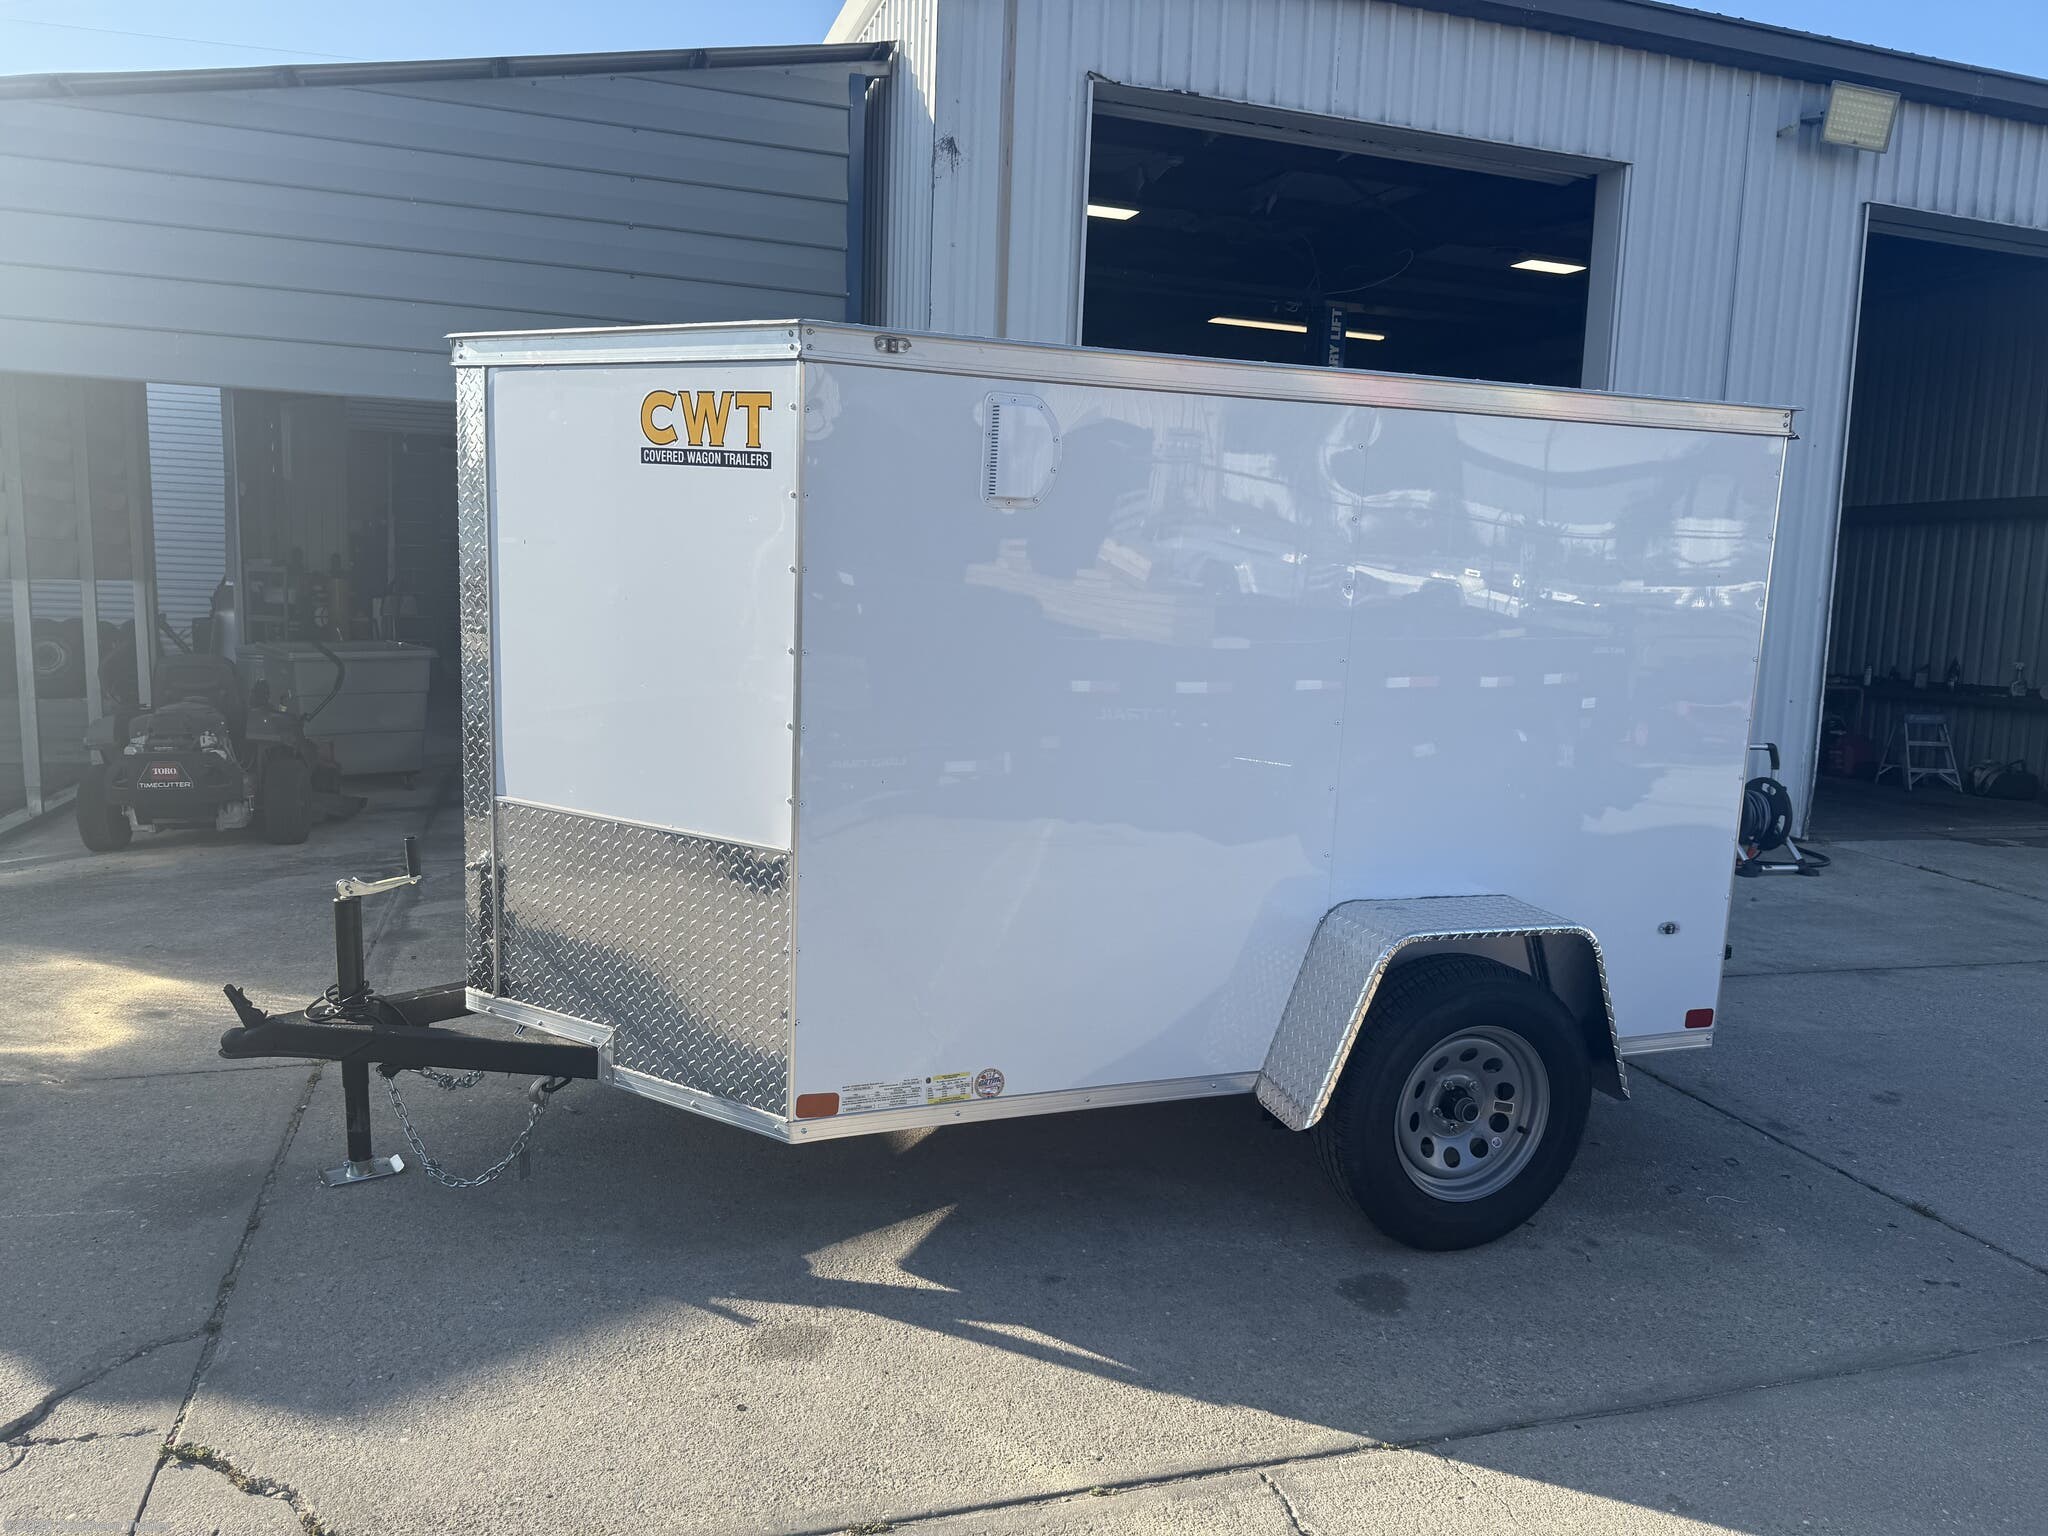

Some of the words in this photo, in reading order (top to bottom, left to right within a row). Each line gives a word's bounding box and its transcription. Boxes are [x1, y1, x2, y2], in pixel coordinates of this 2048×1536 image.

[1330, 308, 1342, 340] LIFT
[641, 390, 772, 448] CWT
[643, 449, 684, 463] COVERED
[686, 451, 721, 465] WAGON
[723, 452, 769, 467] TRAILERS
[152, 767, 176, 775] TORO
